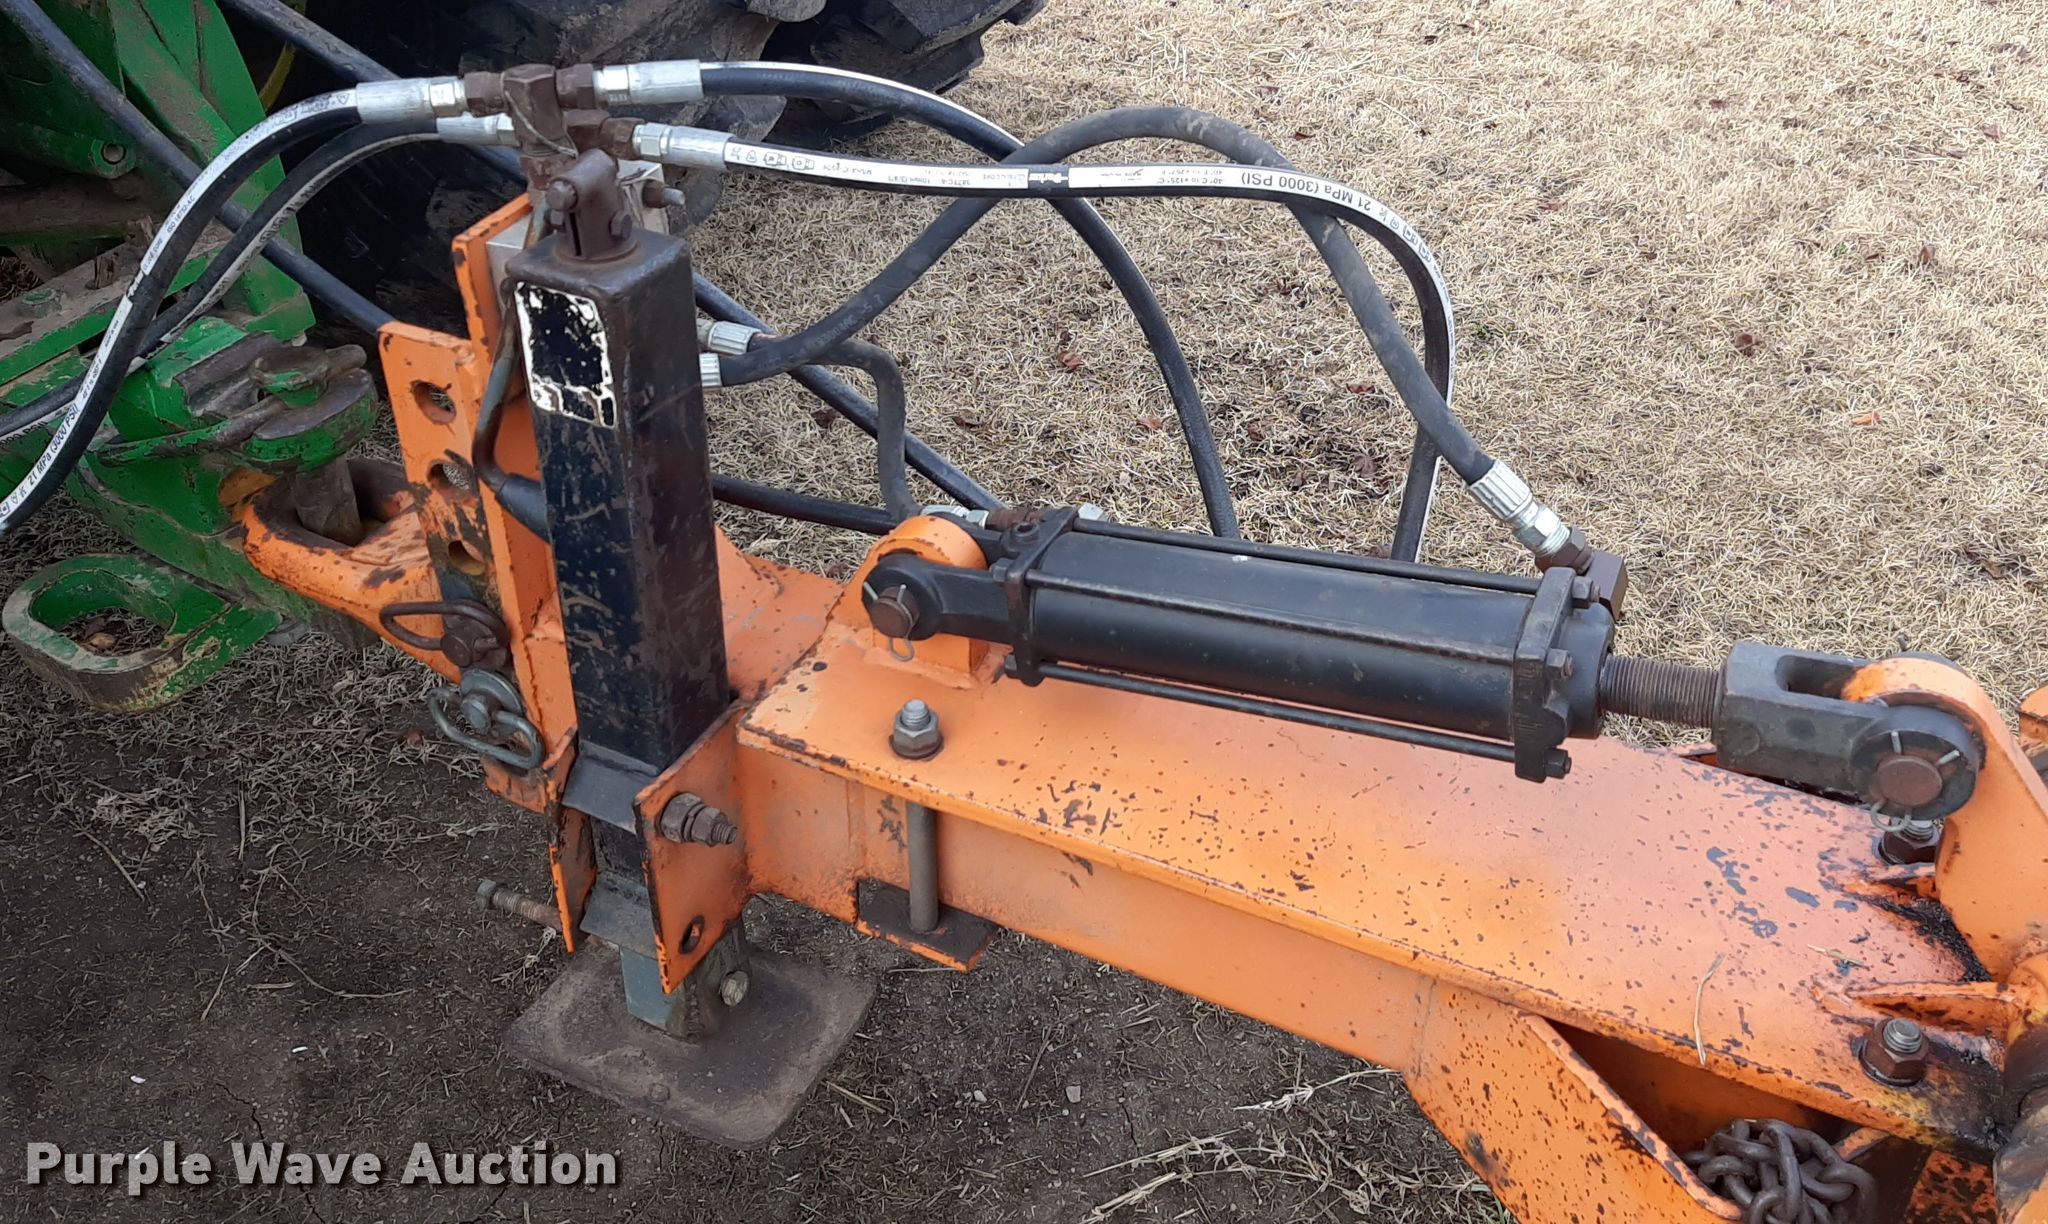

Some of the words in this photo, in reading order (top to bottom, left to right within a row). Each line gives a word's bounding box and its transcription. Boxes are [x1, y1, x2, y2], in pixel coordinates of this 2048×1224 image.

[1241, 171, 1273, 186] PSI)
[1278, 176, 1320, 194] (3000
[1324, 185, 1353, 204] MPa
[1357, 201, 1372, 211] 21
[27, 473, 37, 485] 21
[36, 453, 52, 475] MPa
[50, 426, 67, 454] (3000
[65, 404, 80, 427] PSI)
